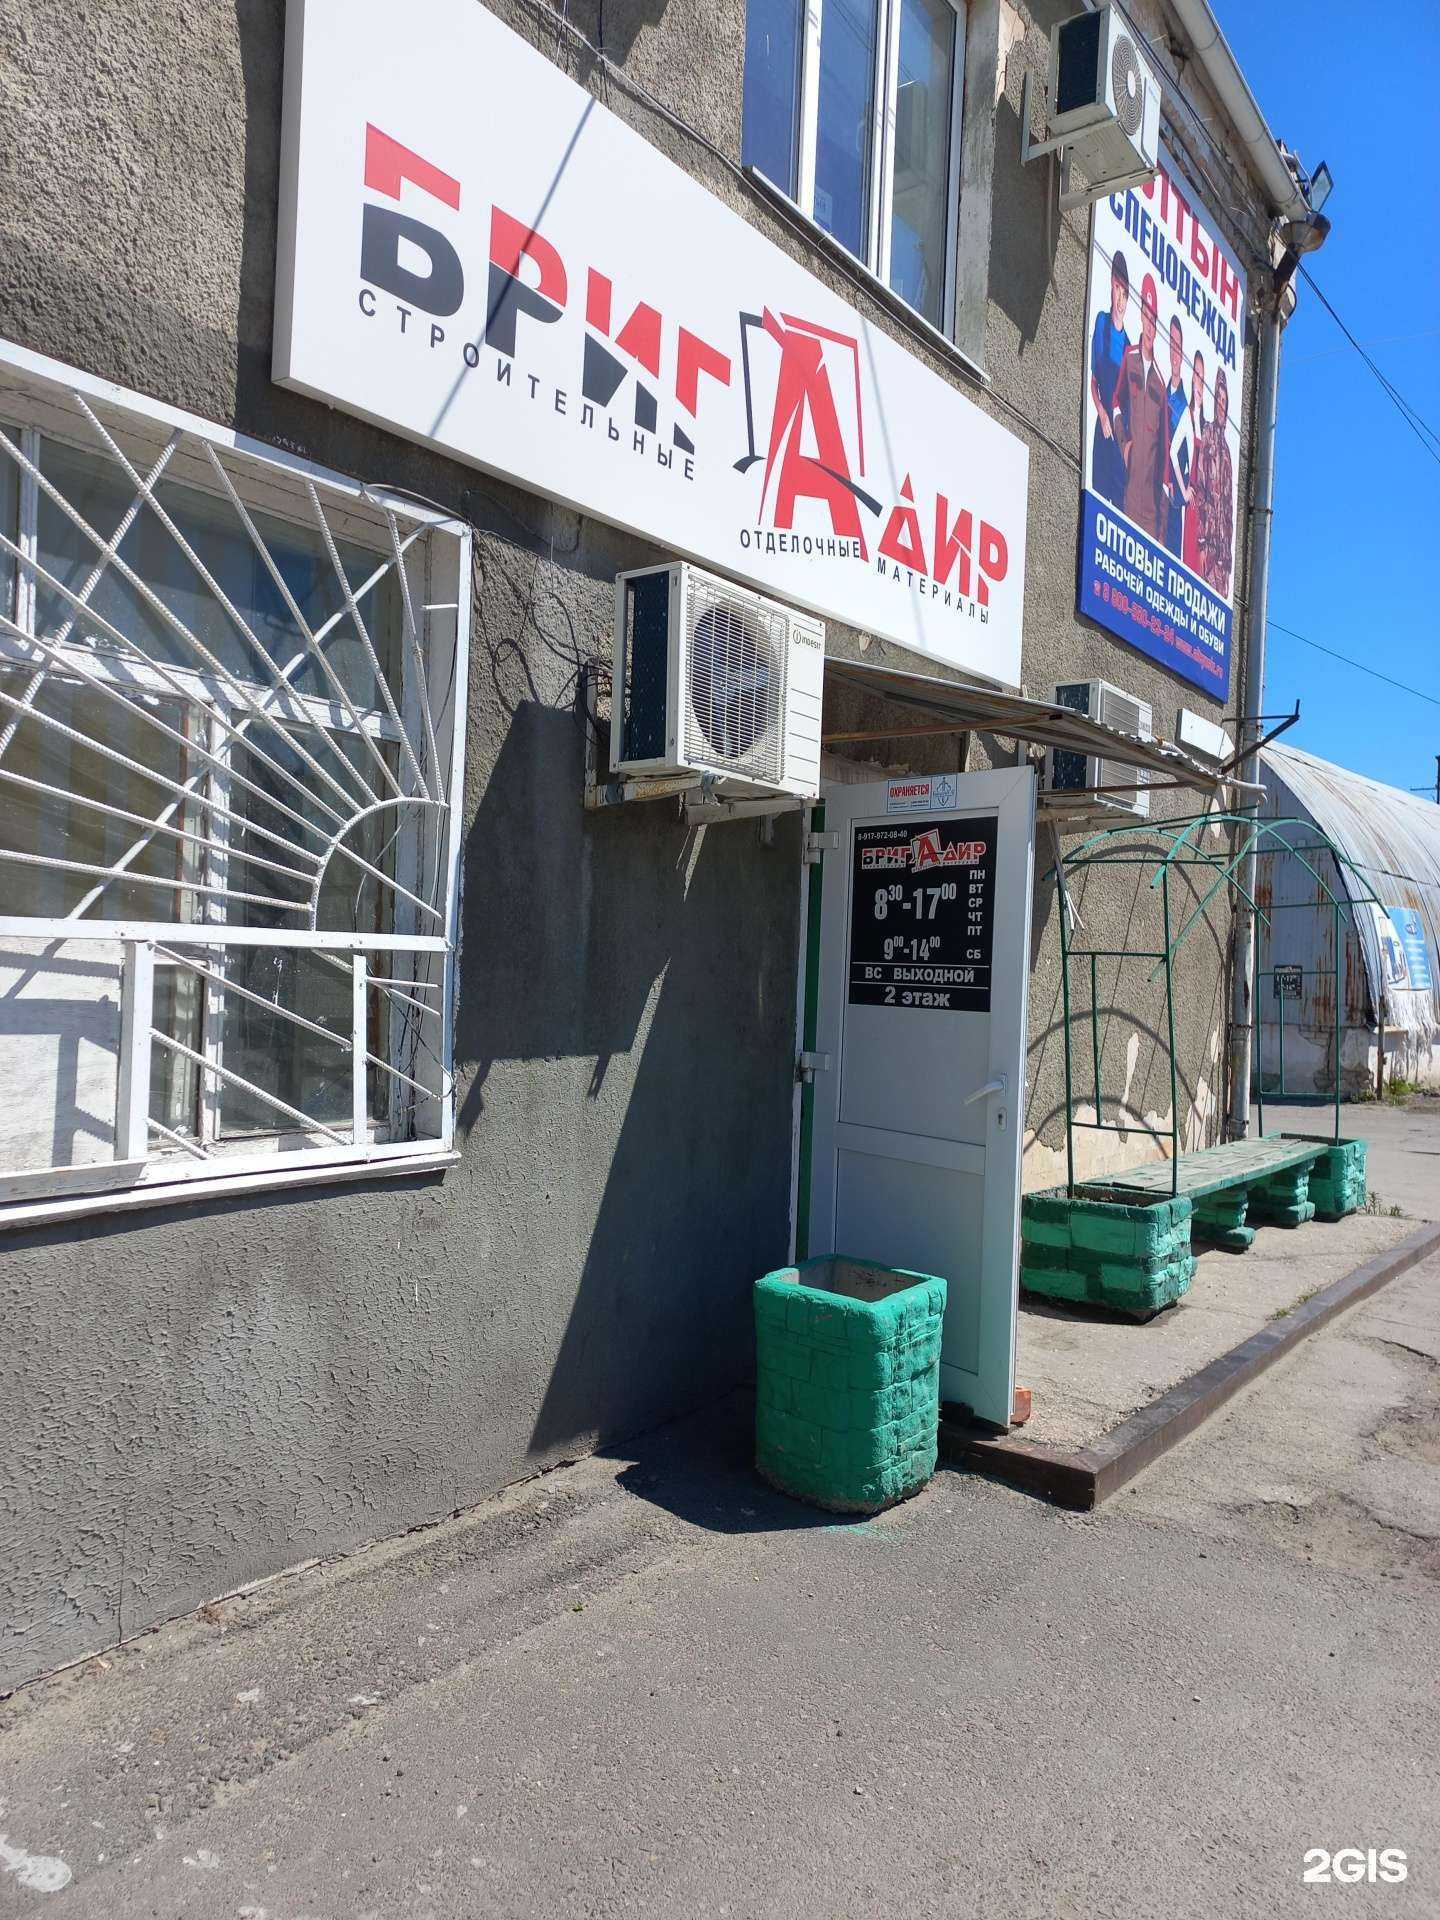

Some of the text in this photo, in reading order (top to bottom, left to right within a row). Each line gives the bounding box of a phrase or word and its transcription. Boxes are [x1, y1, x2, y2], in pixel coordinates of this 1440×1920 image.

[1109, 188, 1236, 371] СПЕЦОДЕЖДА
[360, 122, 1008, 606] БРИГАДИР
[358, 287, 696, 481] СТРОИТЕЛЬНЫЕ
[739, 528, 862, 559] ОТДЕЛОЧНЫЕ
[1095, 512, 1164, 586] ОПТОВЫЕ
[1168, 568, 1226, 635] ПРОДАЖИ
[876, 557, 992, 625] МАТЕРИАЛЫ
[1095, 547, 1144, 597] РАБОЧЕЙ
[1146, 586, 1189, 629] ОДЕЖДЫ
[1190, 617, 1197, 636] И
[1198, 624, 1225, 656] ОБУВИ
[890, 783, 930, 799] ОХРАНЯЕТСЯ
[969, 869, 986, 880] ПН
[968, 883, 984, 894] ВТ
[968, 897, 983, 908] СР
[968, 911, 982, 922] ЧТ
[967, 925, 982, 936] ПТ
[966, 948, 981, 959] СБ
[864, 966, 975, 984] ВС ВЫХОДНОЙ
[884, 986, 896, 1004] 2
